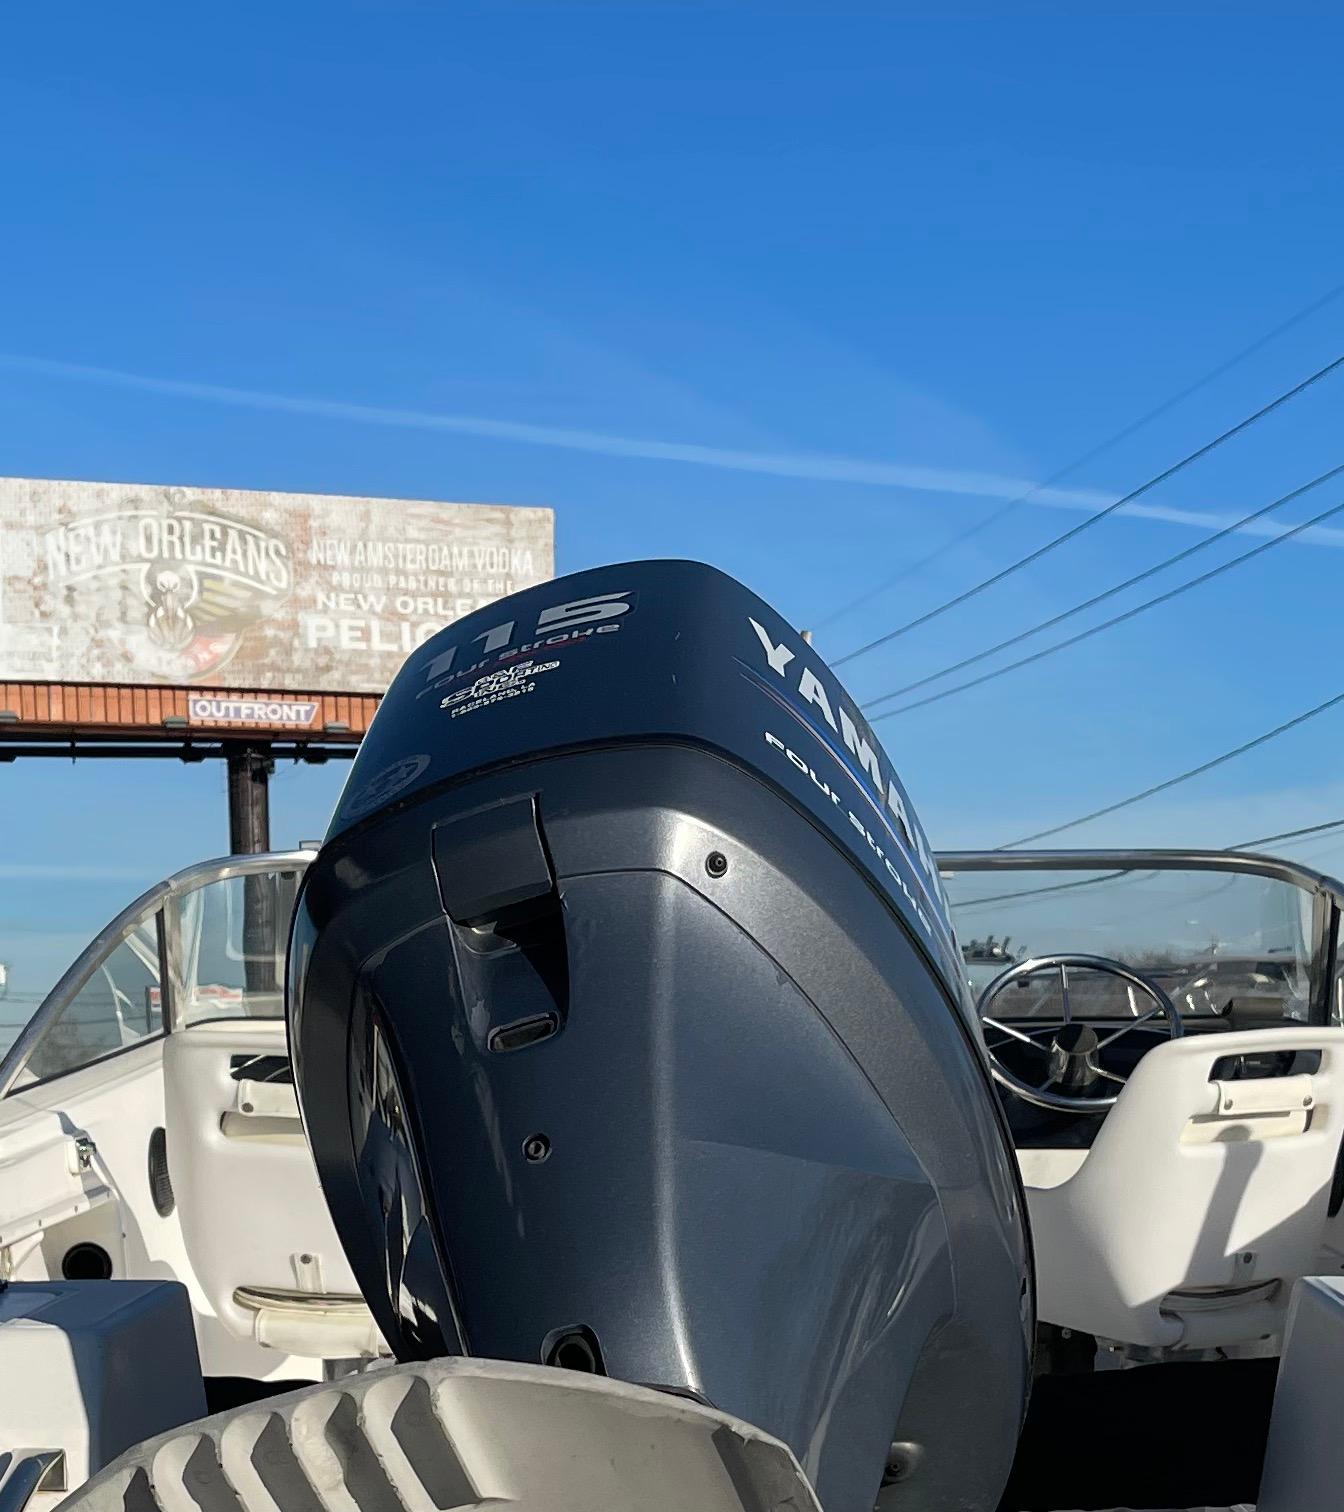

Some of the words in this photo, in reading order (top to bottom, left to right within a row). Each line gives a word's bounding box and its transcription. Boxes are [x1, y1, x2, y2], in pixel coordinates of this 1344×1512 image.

[47, 524, 122, 580] NEW
[138, 518, 288, 589] ORLEANS
[311, 540, 351, 566] NEW
[355, 541, 469, 571] AMSTERDAM
[474, 547, 533, 576] VODKA
[316, 593, 385, 612] NEW
[195, 700, 312, 721] OUTFRONT
